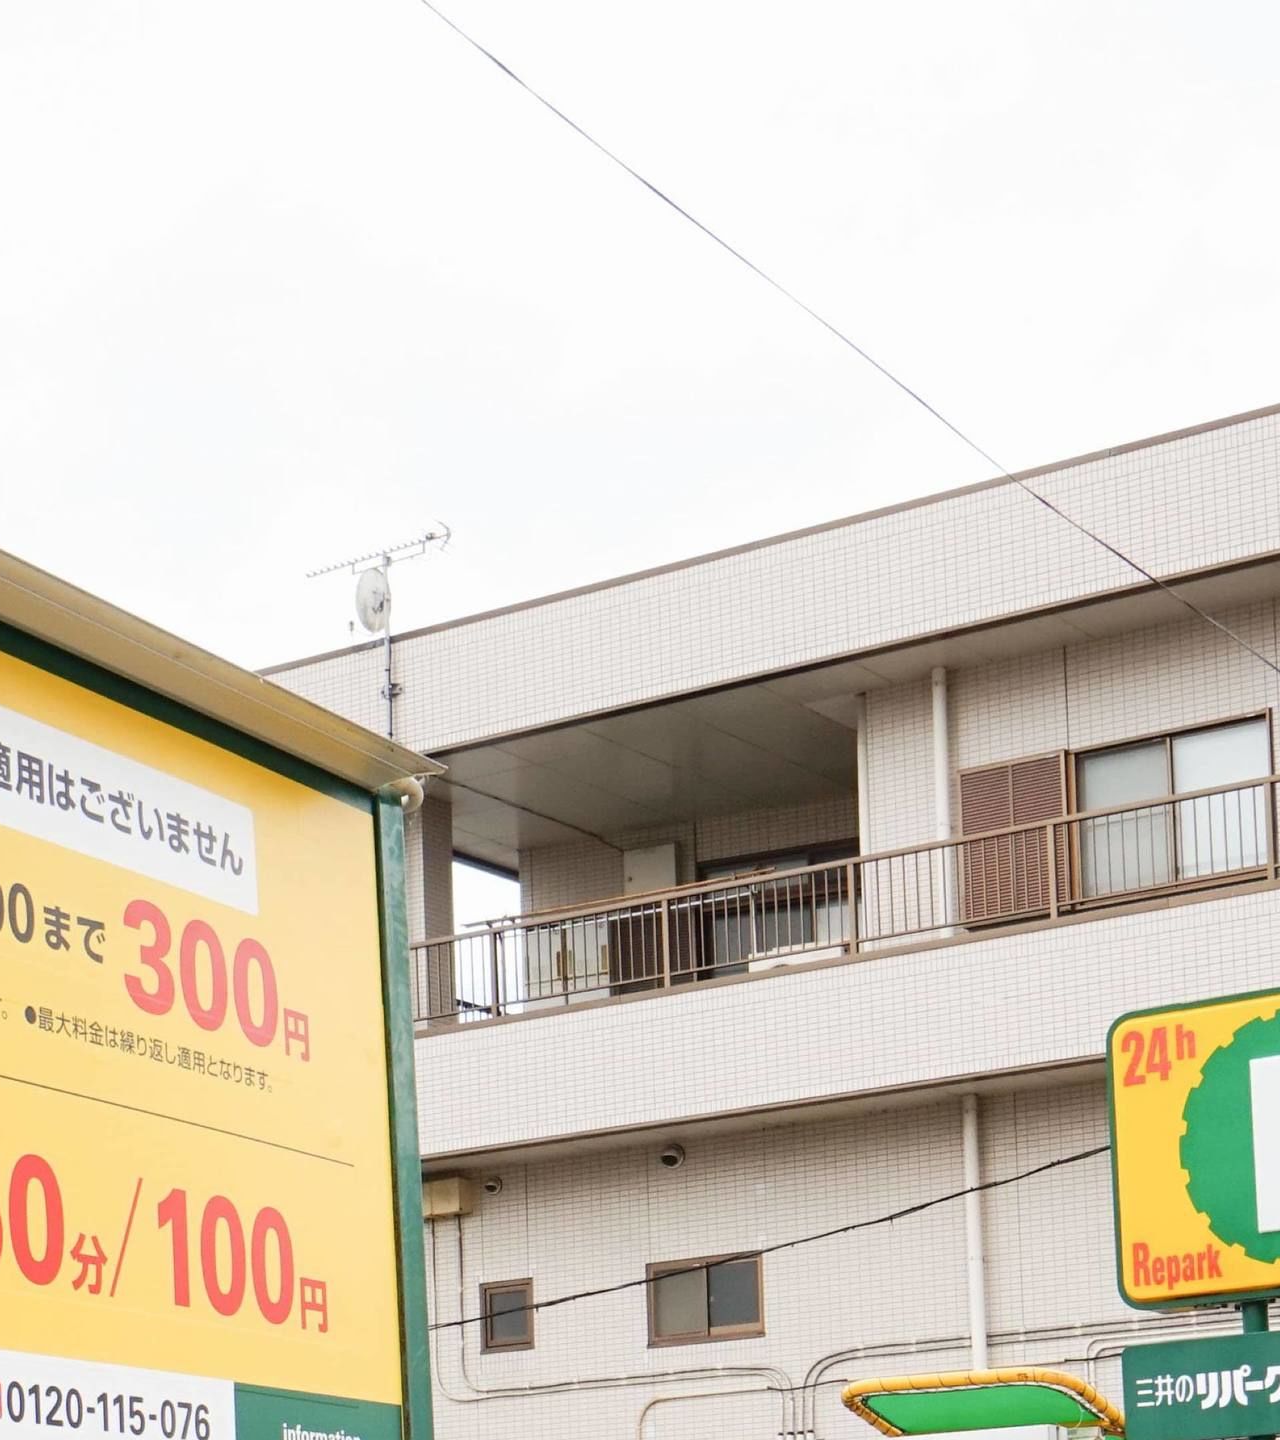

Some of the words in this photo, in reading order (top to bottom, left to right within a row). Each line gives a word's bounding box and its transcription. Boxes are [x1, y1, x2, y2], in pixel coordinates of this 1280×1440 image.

[123, 898, 311, 1062] 300円
[1121, 1023, 1196, 1087] 24h
[1132, 1242, 1222, 1290] Repark
